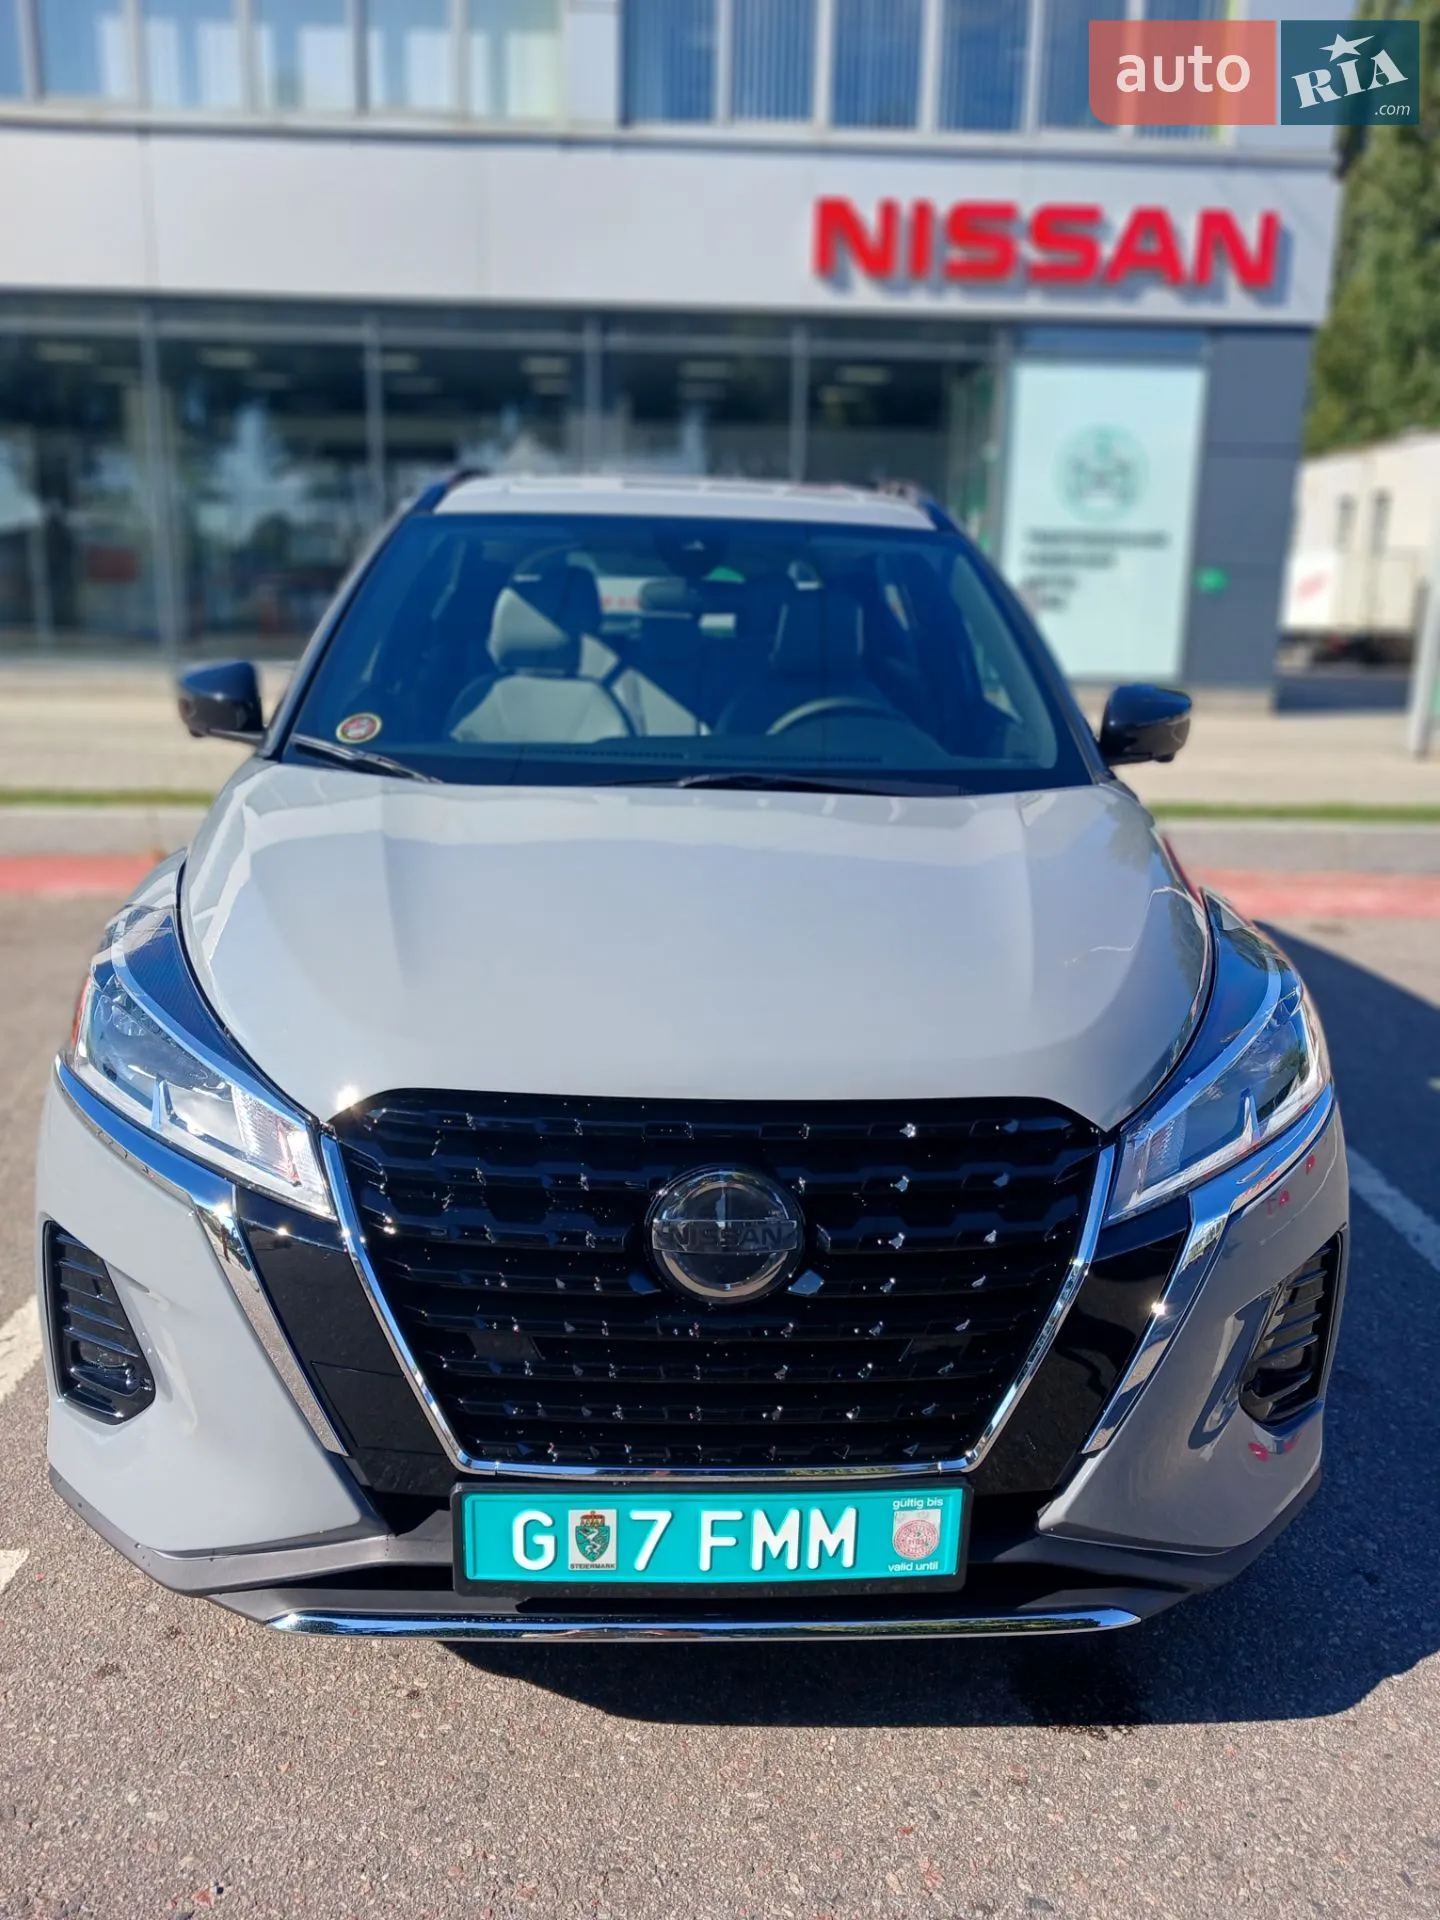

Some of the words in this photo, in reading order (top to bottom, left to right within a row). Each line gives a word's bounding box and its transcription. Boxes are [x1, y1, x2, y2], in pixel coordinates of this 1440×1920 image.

[815, 195, 1281, 289] NISSAN
[672, 1222, 784, 1249] NISSAN
[892, 1497, 924, 1510] gültig
[926, 1496, 944, 1507] bis
[512, 1509, 556, 1571] G
[629, 1509, 673, 1571] 7
[699, 1506, 857, 1572] FMM
[888, 1562, 914, 1572] valid
[915, 1561, 939, 1571] until
